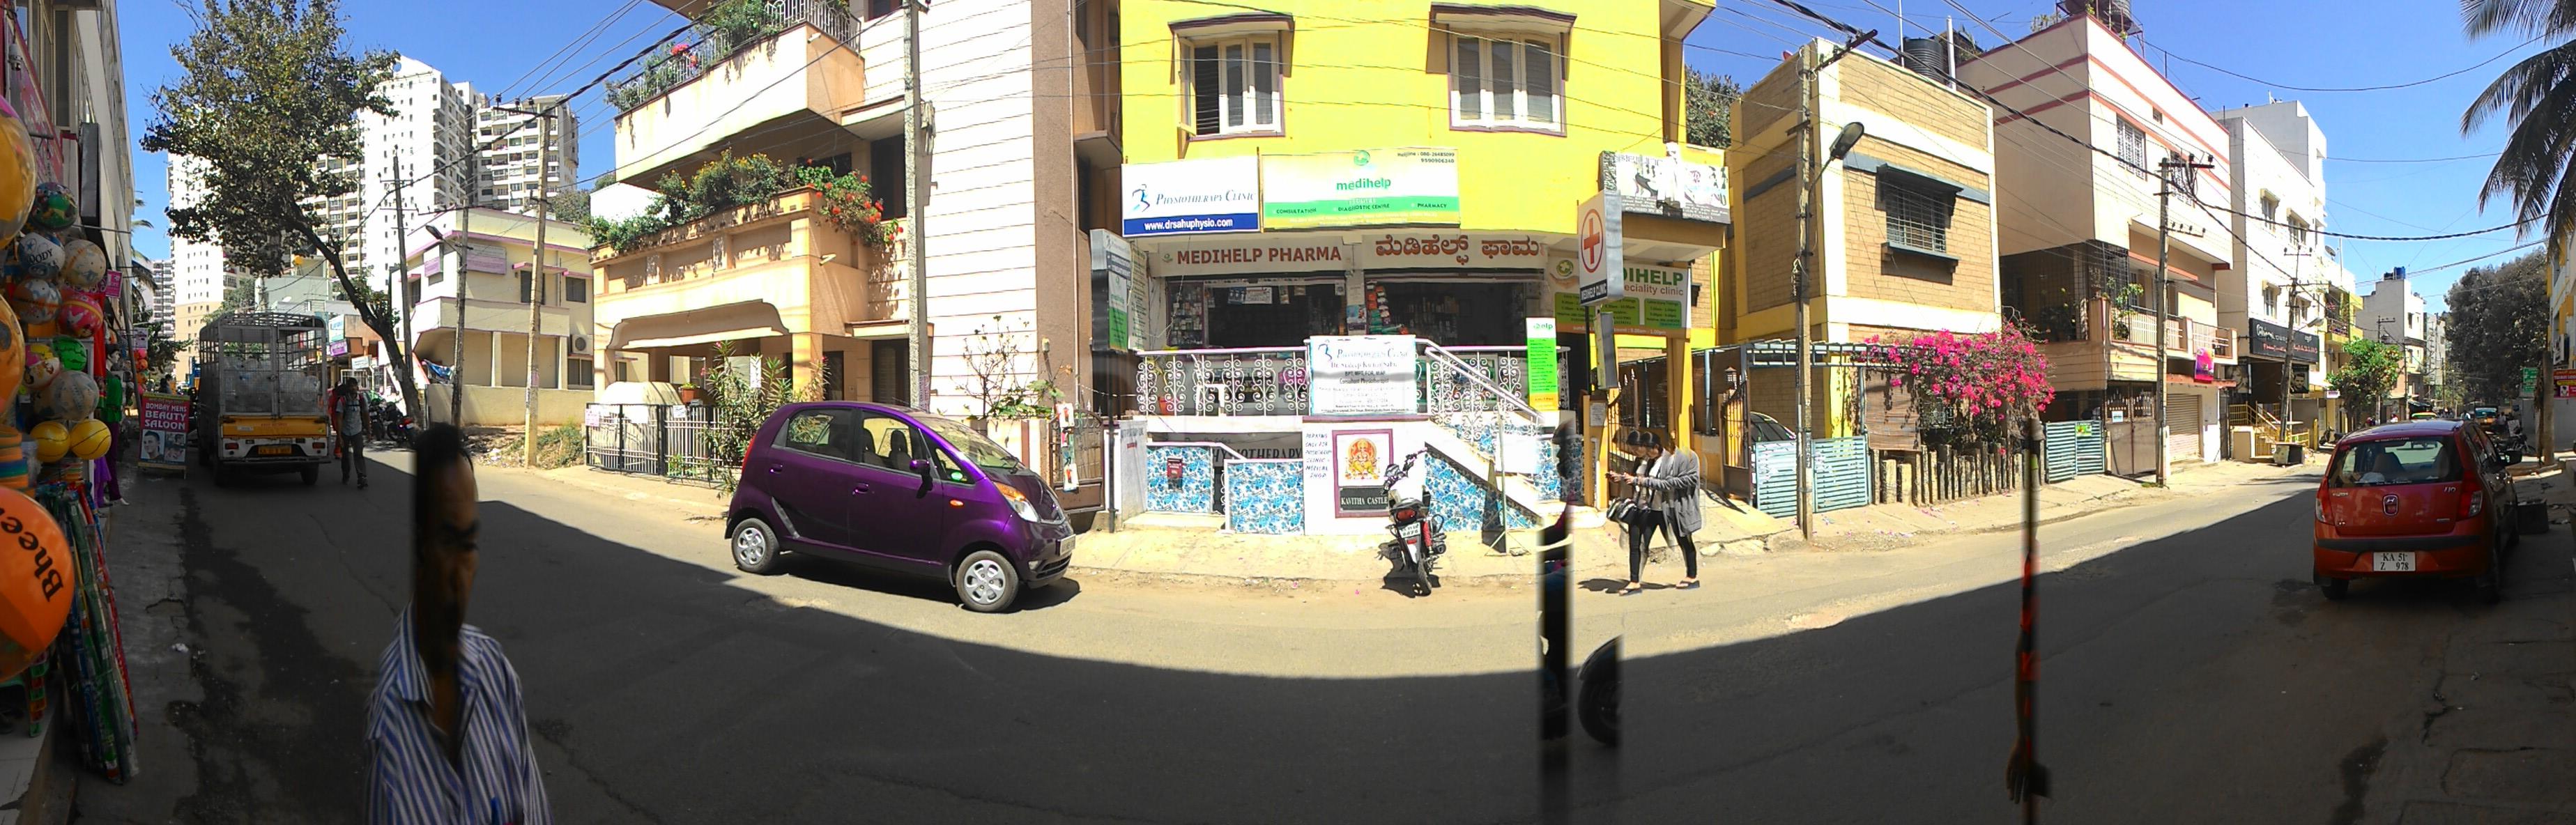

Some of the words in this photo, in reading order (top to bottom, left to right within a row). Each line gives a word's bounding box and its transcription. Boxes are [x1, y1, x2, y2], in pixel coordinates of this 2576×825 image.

[1336, 177, 1391, 191] medihelp
[1144, 218, 1233, 231] www.drsahuphysio.com
[27, 248, 53, 265] OODY
[1176, 247, 1263, 265] MEDIHELP
[1268, 245, 1342, 263] PHARMA
[1660, 286, 1684, 296] clinic
[145, 403, 171, 412] BOMBAY
[171, 405, 187, 413] MENS
[145, 410, 187, 422] BEAUTY
[144, 419, 186, 431] SALOON
[1341, 496, 1366, 505] KAVITHA
[1367, 496, 1388, 505] CASTLE
[0, 507, 64, 603] Bhee
[2382, 553, 2396, 562] KA
[2398, 553, 2407, 562] 51
[2380, 561, 2386, 571] Z
[2395, 561, 2409, 571] 978
